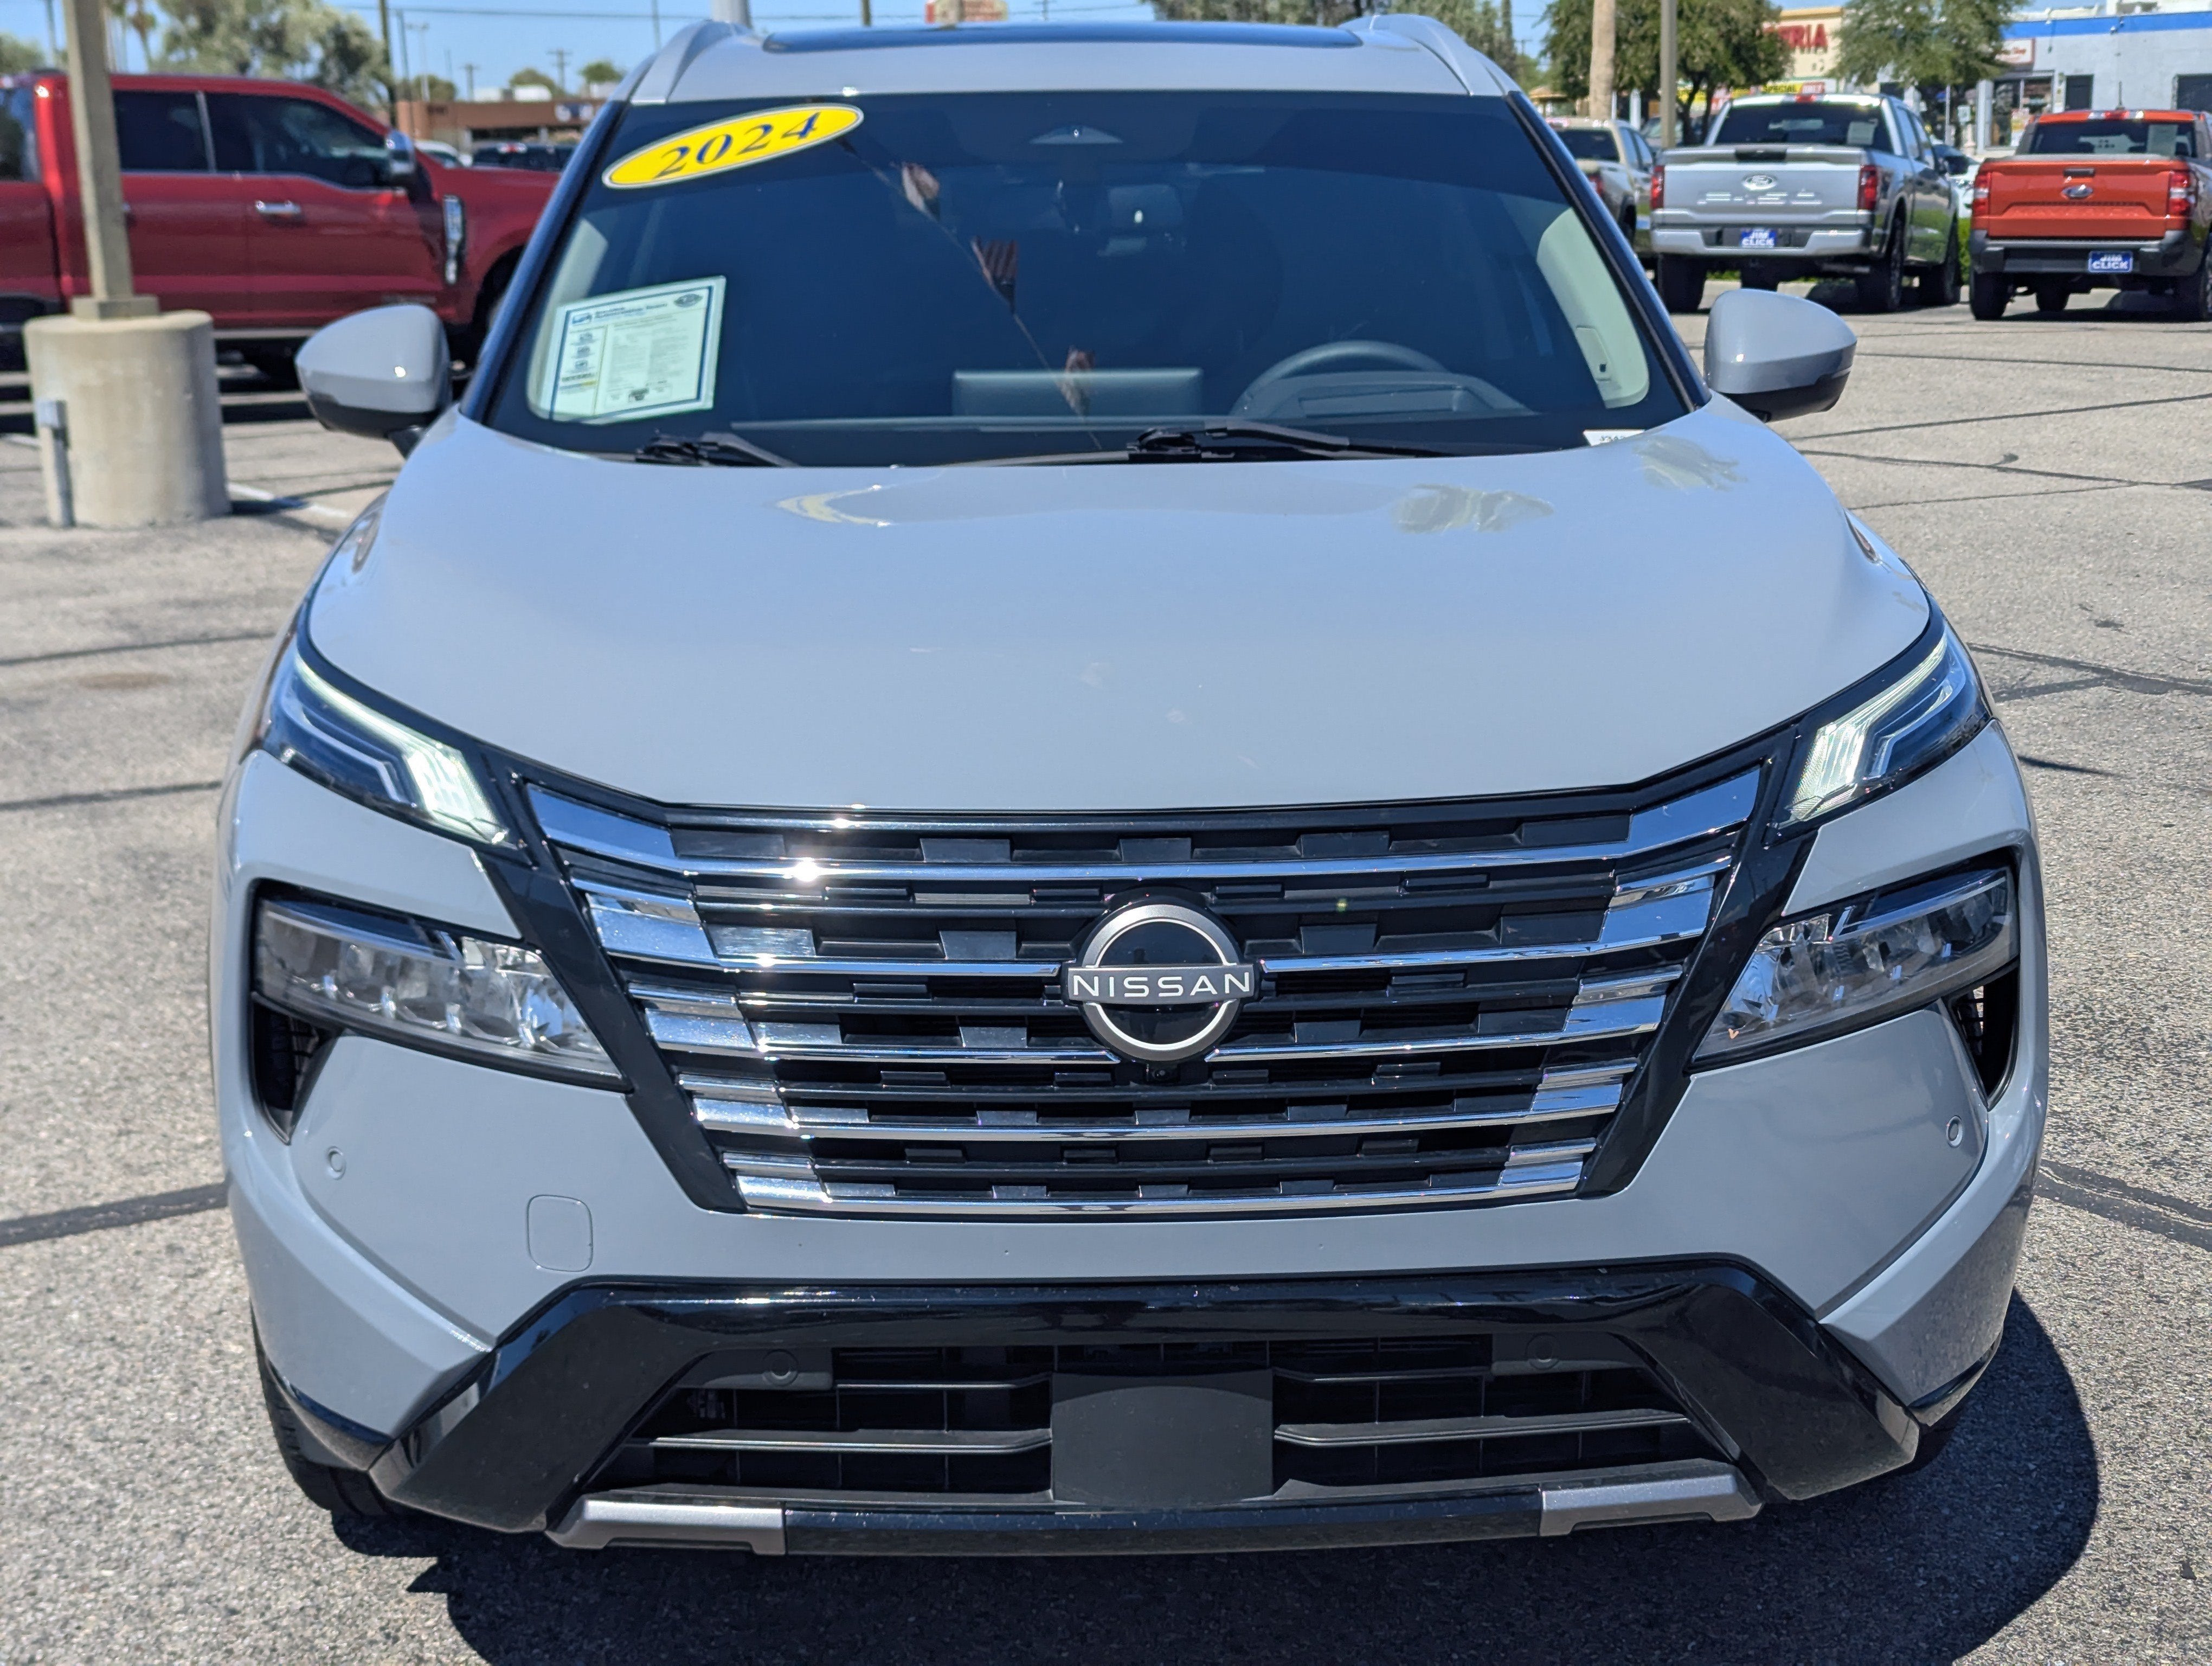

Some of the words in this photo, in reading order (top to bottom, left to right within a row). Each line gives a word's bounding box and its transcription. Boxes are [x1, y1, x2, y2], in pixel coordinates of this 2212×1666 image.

[654, 112, 821, 178] 2024
[2092, 260, 2128, 269] CLICK
[1073, 972, 1249, 997] NISSAN
